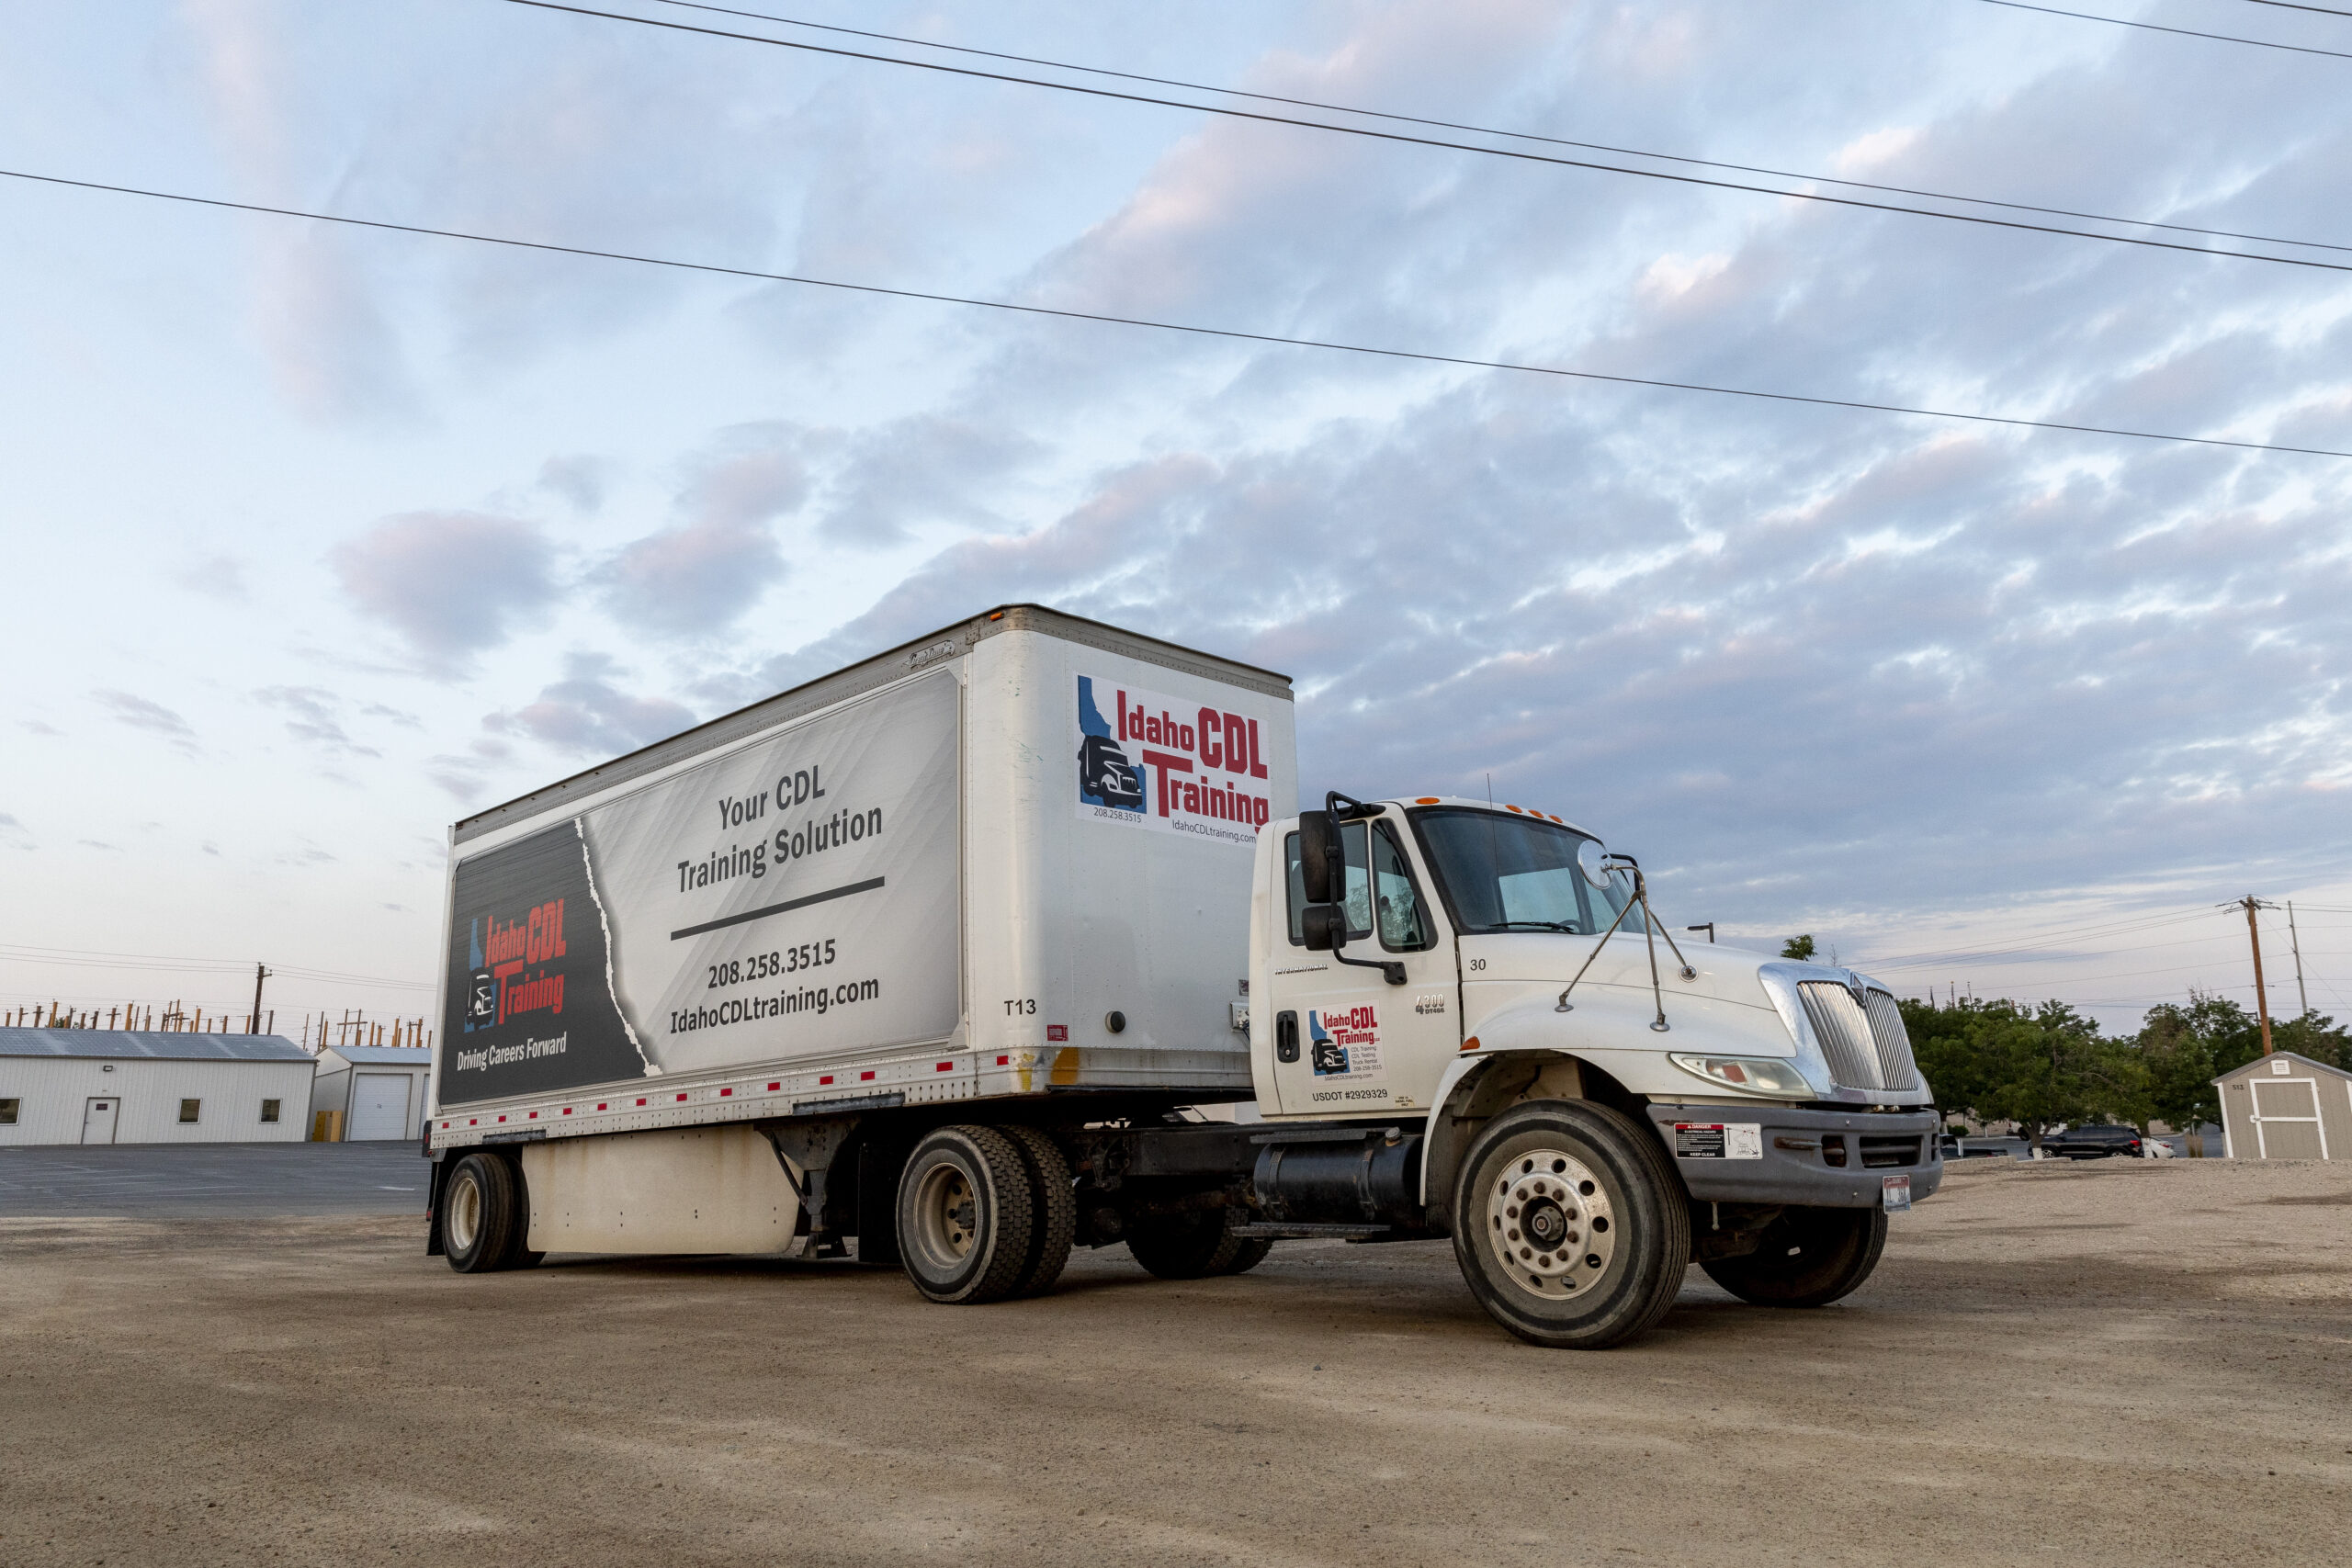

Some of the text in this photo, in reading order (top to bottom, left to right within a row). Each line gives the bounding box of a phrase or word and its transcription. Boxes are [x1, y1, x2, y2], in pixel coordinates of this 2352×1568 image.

[1117, 690, 1268, 780] Idaho CDL
[718, 765, 825, 830] Your CDL
[1142, 749, 1269, 835] Training
[1094, 807, 1142, 823] 208.258.3515
[1172, 818, 1257, 844] IdahoCDLtraining.com
[678, 807, 882, 893] Training Solution
[485, 898, 567, 968] Idaho CDL
[707, 939, 836, 989] 208.258.3515
[1274, 964, 1329, 976] INTERNATIONAL
[1470, 959, 1487, 971] 30
[494, 960, 565, 1025] Training
[671, 978, 879, 1034] IdahoCDLtraining.com
[1004, 998, 1036, 1016] T13
[1323, 1006, 1378, 1030] Idaho CDL
[1332, 1029, 1374, 1047] Training
[457, 1032, 567, 1072] Driving Careers Forward
[1312, 1089, 1387, 1101] USDOT #2929329
